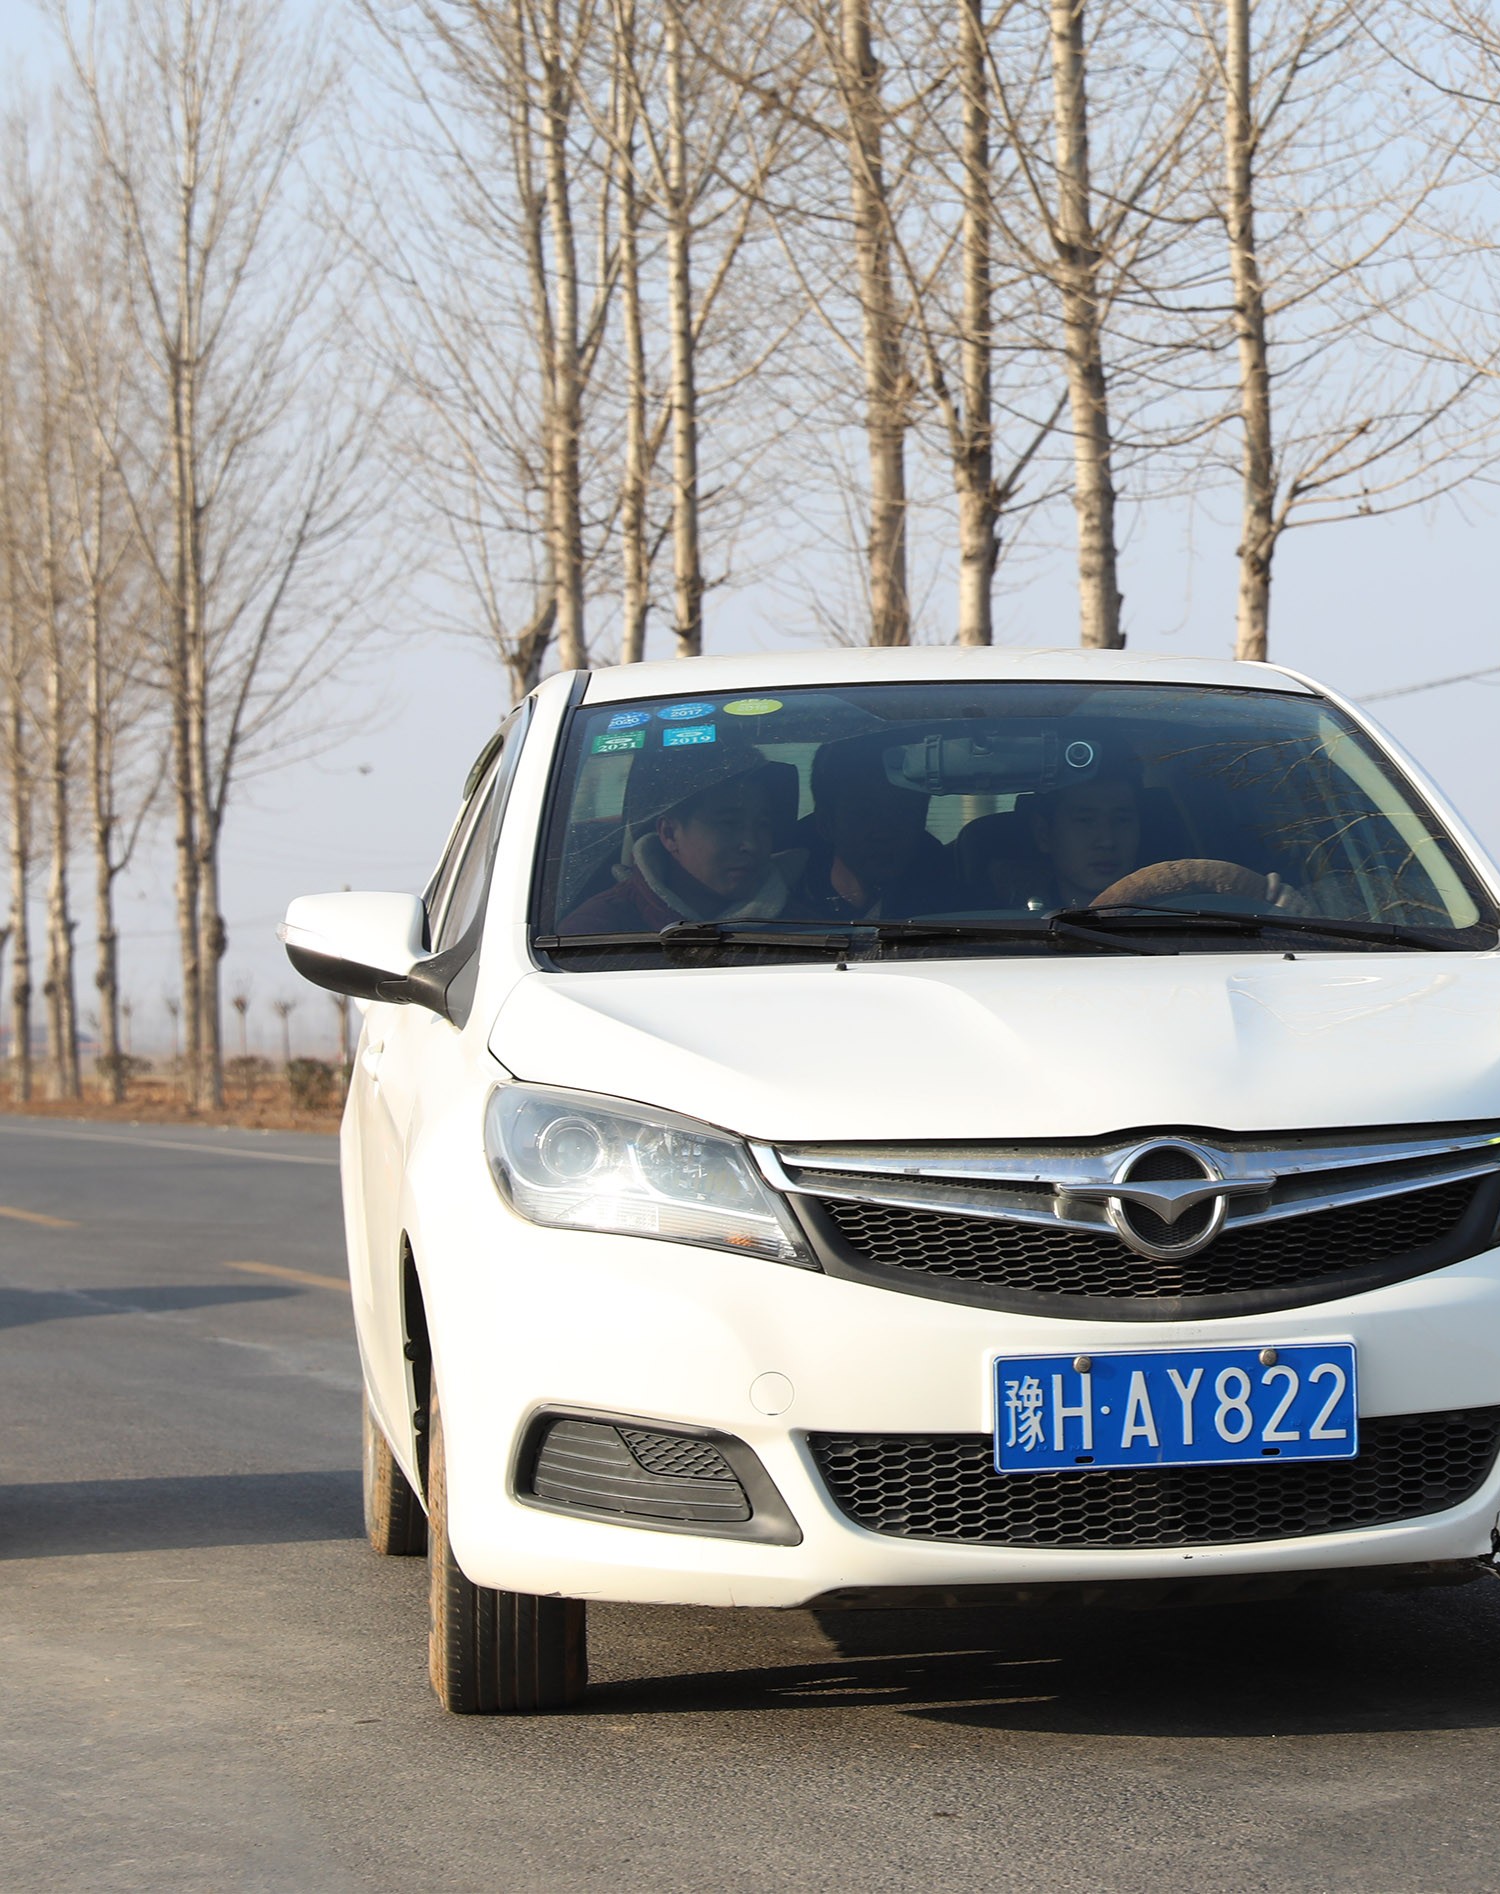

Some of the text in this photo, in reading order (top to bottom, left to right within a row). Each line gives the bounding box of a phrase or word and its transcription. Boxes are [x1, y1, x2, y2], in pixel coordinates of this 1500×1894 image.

[670, 708, 703, 718] 2017
[609, 717, 640, 728] 2020
[670, 735, 711, 746] 2019
[598, 741, 637, 753] 2021
[1004, 1363, 1347, 1452] 豫H·AY822
